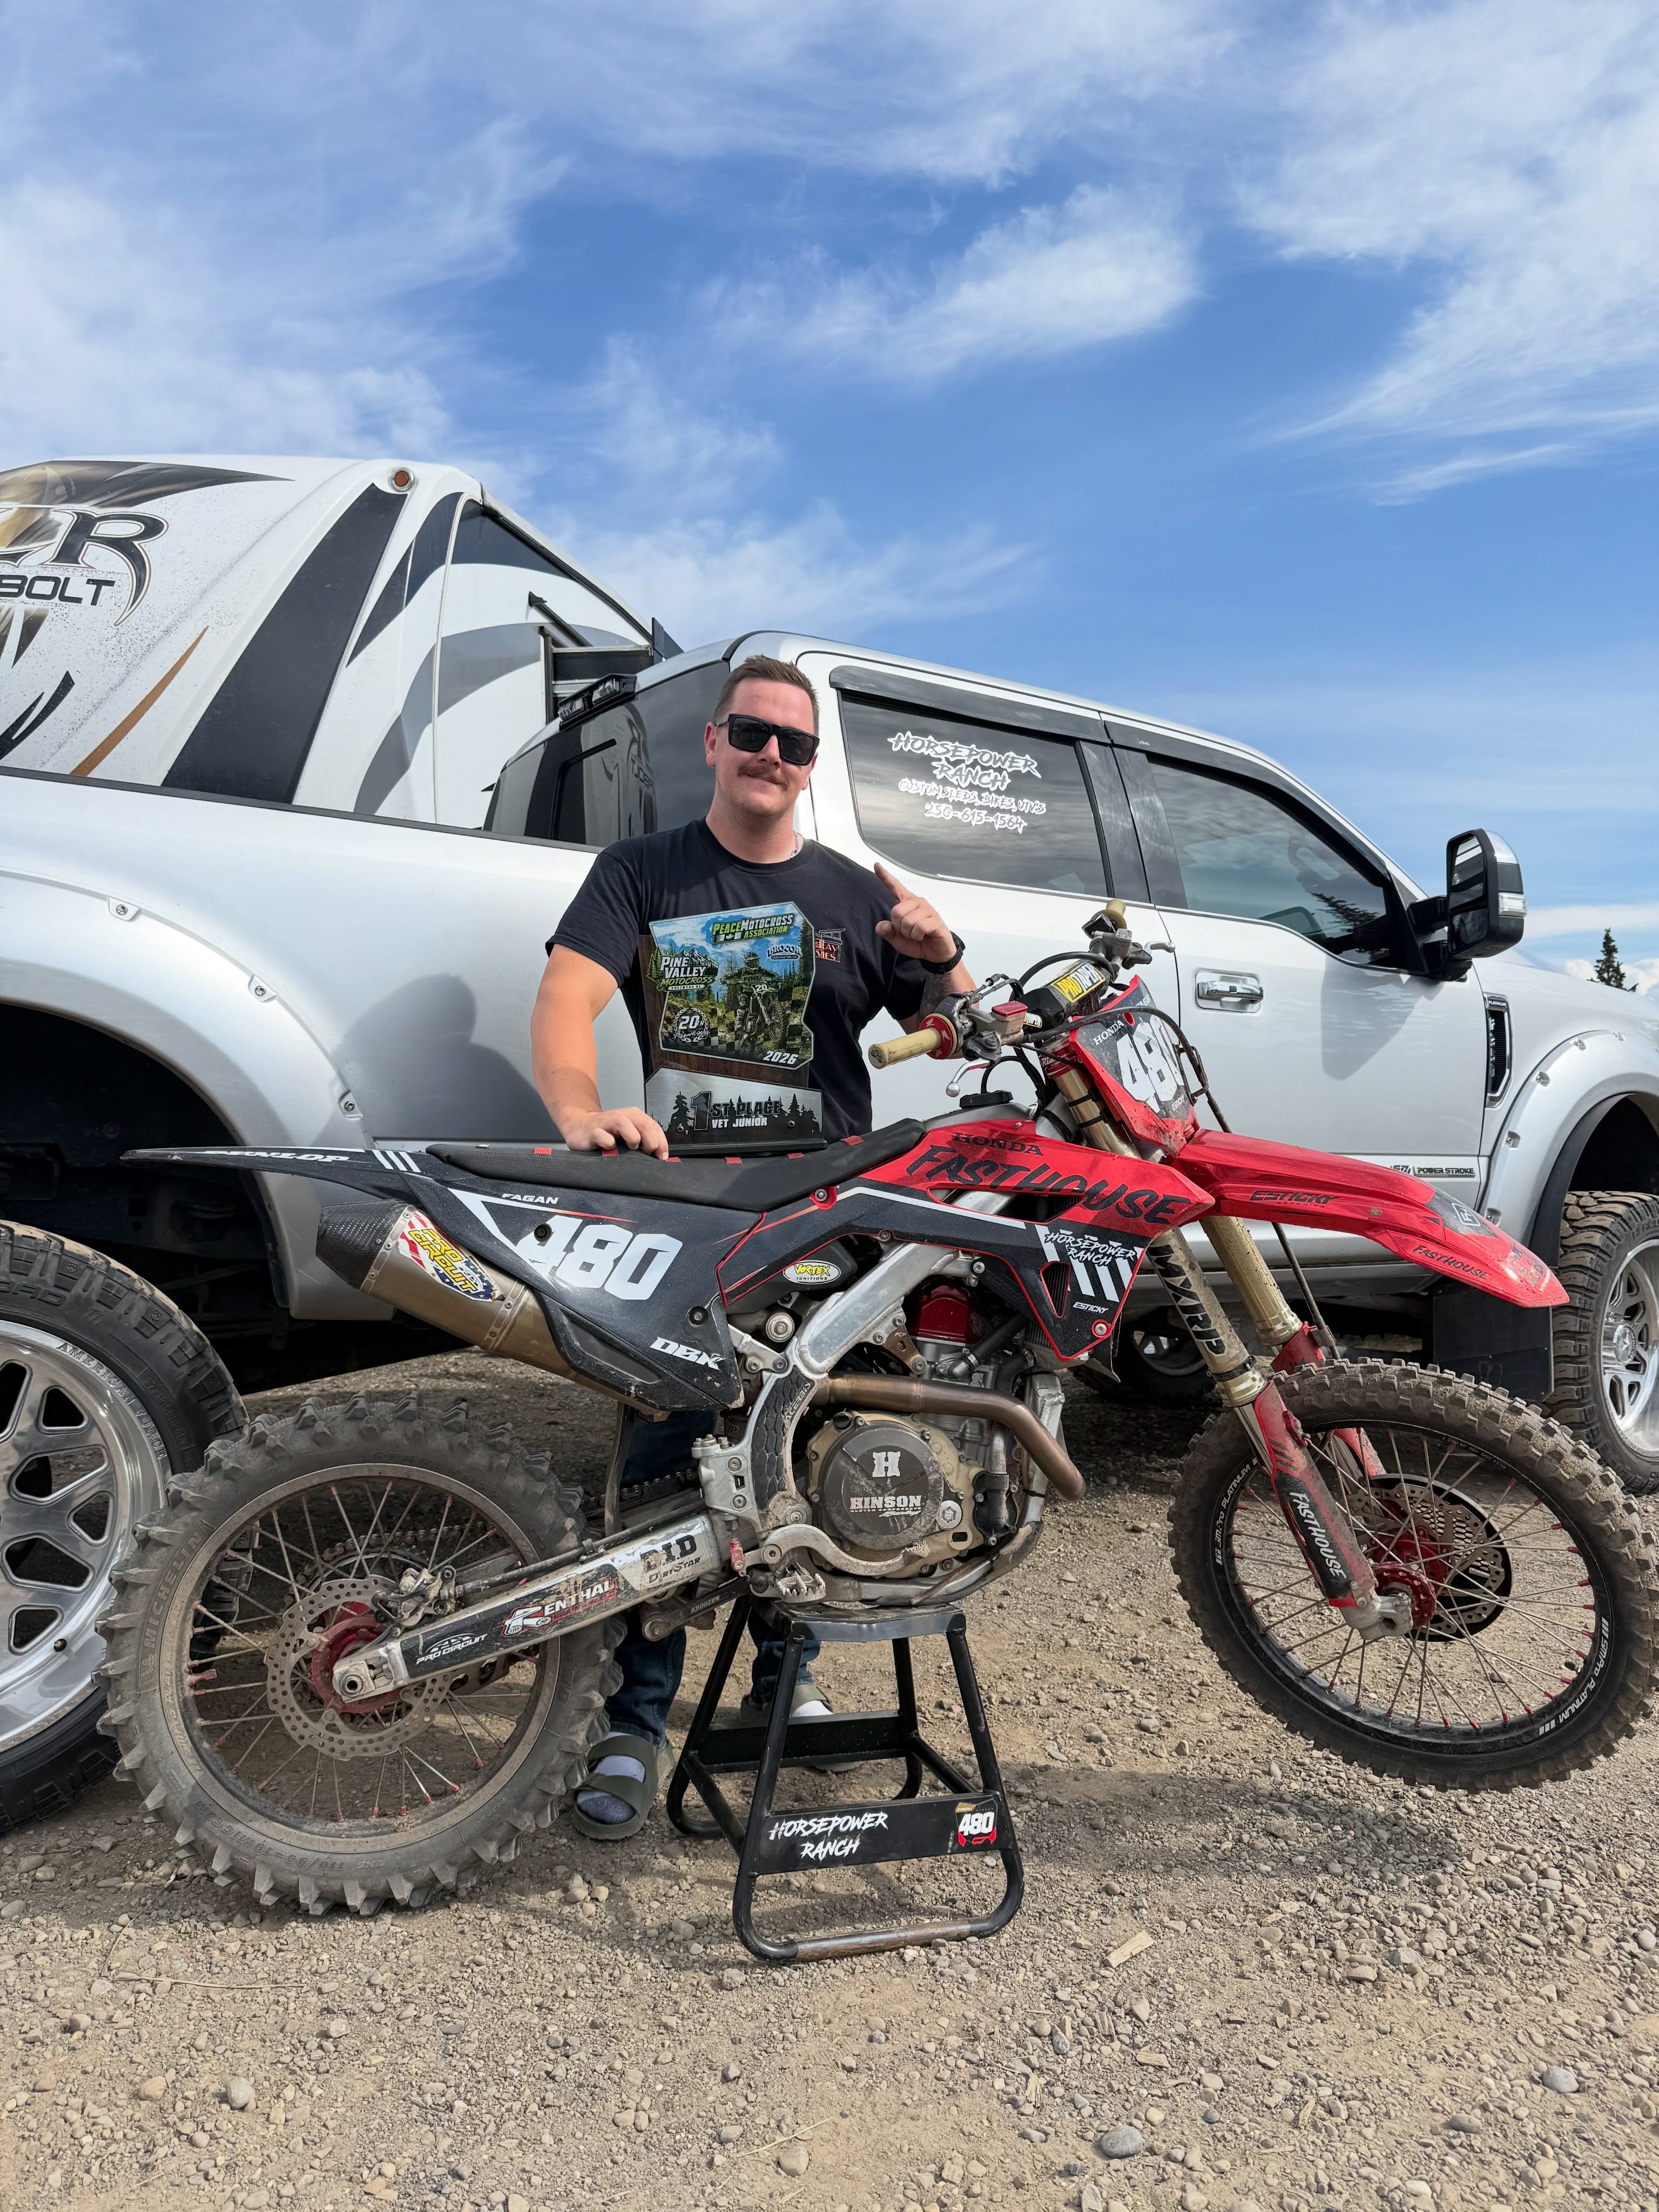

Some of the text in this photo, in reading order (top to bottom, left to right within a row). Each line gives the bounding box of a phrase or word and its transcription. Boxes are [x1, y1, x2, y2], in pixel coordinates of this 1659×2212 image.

[0, 575, 116, 606] BOLT
[887, 731, 1042, 779] HORSEPOWER
[932, 758, 1011, 791] RANCH
[744, 925, 788, 939] ASSOCIATION
[659, 956, 690, 971] PINE
[665, 966, 707, 979] VALLEY
[659, 976, 713, 988] MOTOCROSS
[1092, 1020, 1125, 1046] HONDA
[763, 1051, 799, 1065] 2026
[736, 1101, 781, 1116] PLACE
[712, 1117, 767, 1129] VET JUNIOR
[204, 1150, 350, 1163] DUNLOP
[953, 1131, 1043, 1156] HONDA
[906, 1144, 1191, 1224] FASTHOUSE
[1249, 1190, 1340, 1205] ESTICKY
[501, 1192, 559, 1205] FAGAN
[421, 1228, 464, 1263] PRO
[515, 1214, 683, 1300] 480
[1044, 1232, 1136, 1262] HORSEPOWER
[1065, 1244, 1112, 1266] RANCH
[408, 1230, 478, 1292] CIRCUIT
[794, 1264, 831, 1276] VORTEX
[1412, 1245, 1491, 1280] FASTHOUSE
[1073, 1301, 1109, 1313] ESTICKY
[56, 1342, 167, 1460] AMERICAN FORCE
[872, 1451, 900, 1478] H
[1220, 1464, 1251, 1509] PLATINUM
[850, 1495, 921, 1509] HINSON
[1290, 1491, 1346, 1580] FASTHOUSE
[144, 1532, 204, 1648] MICHELIN
[504, 1580, 613, 1635] RENTHAL
[416, 1634, 488, 1665] PRO CIRCUIT
[1557, 1676, 1597, 1723] PLATINUM
[768, 1810, 889, 1842] HORSEPOWER
[958, 1812, 995, 1836] 480
[800, 1835, 861, 1863] RANCH
